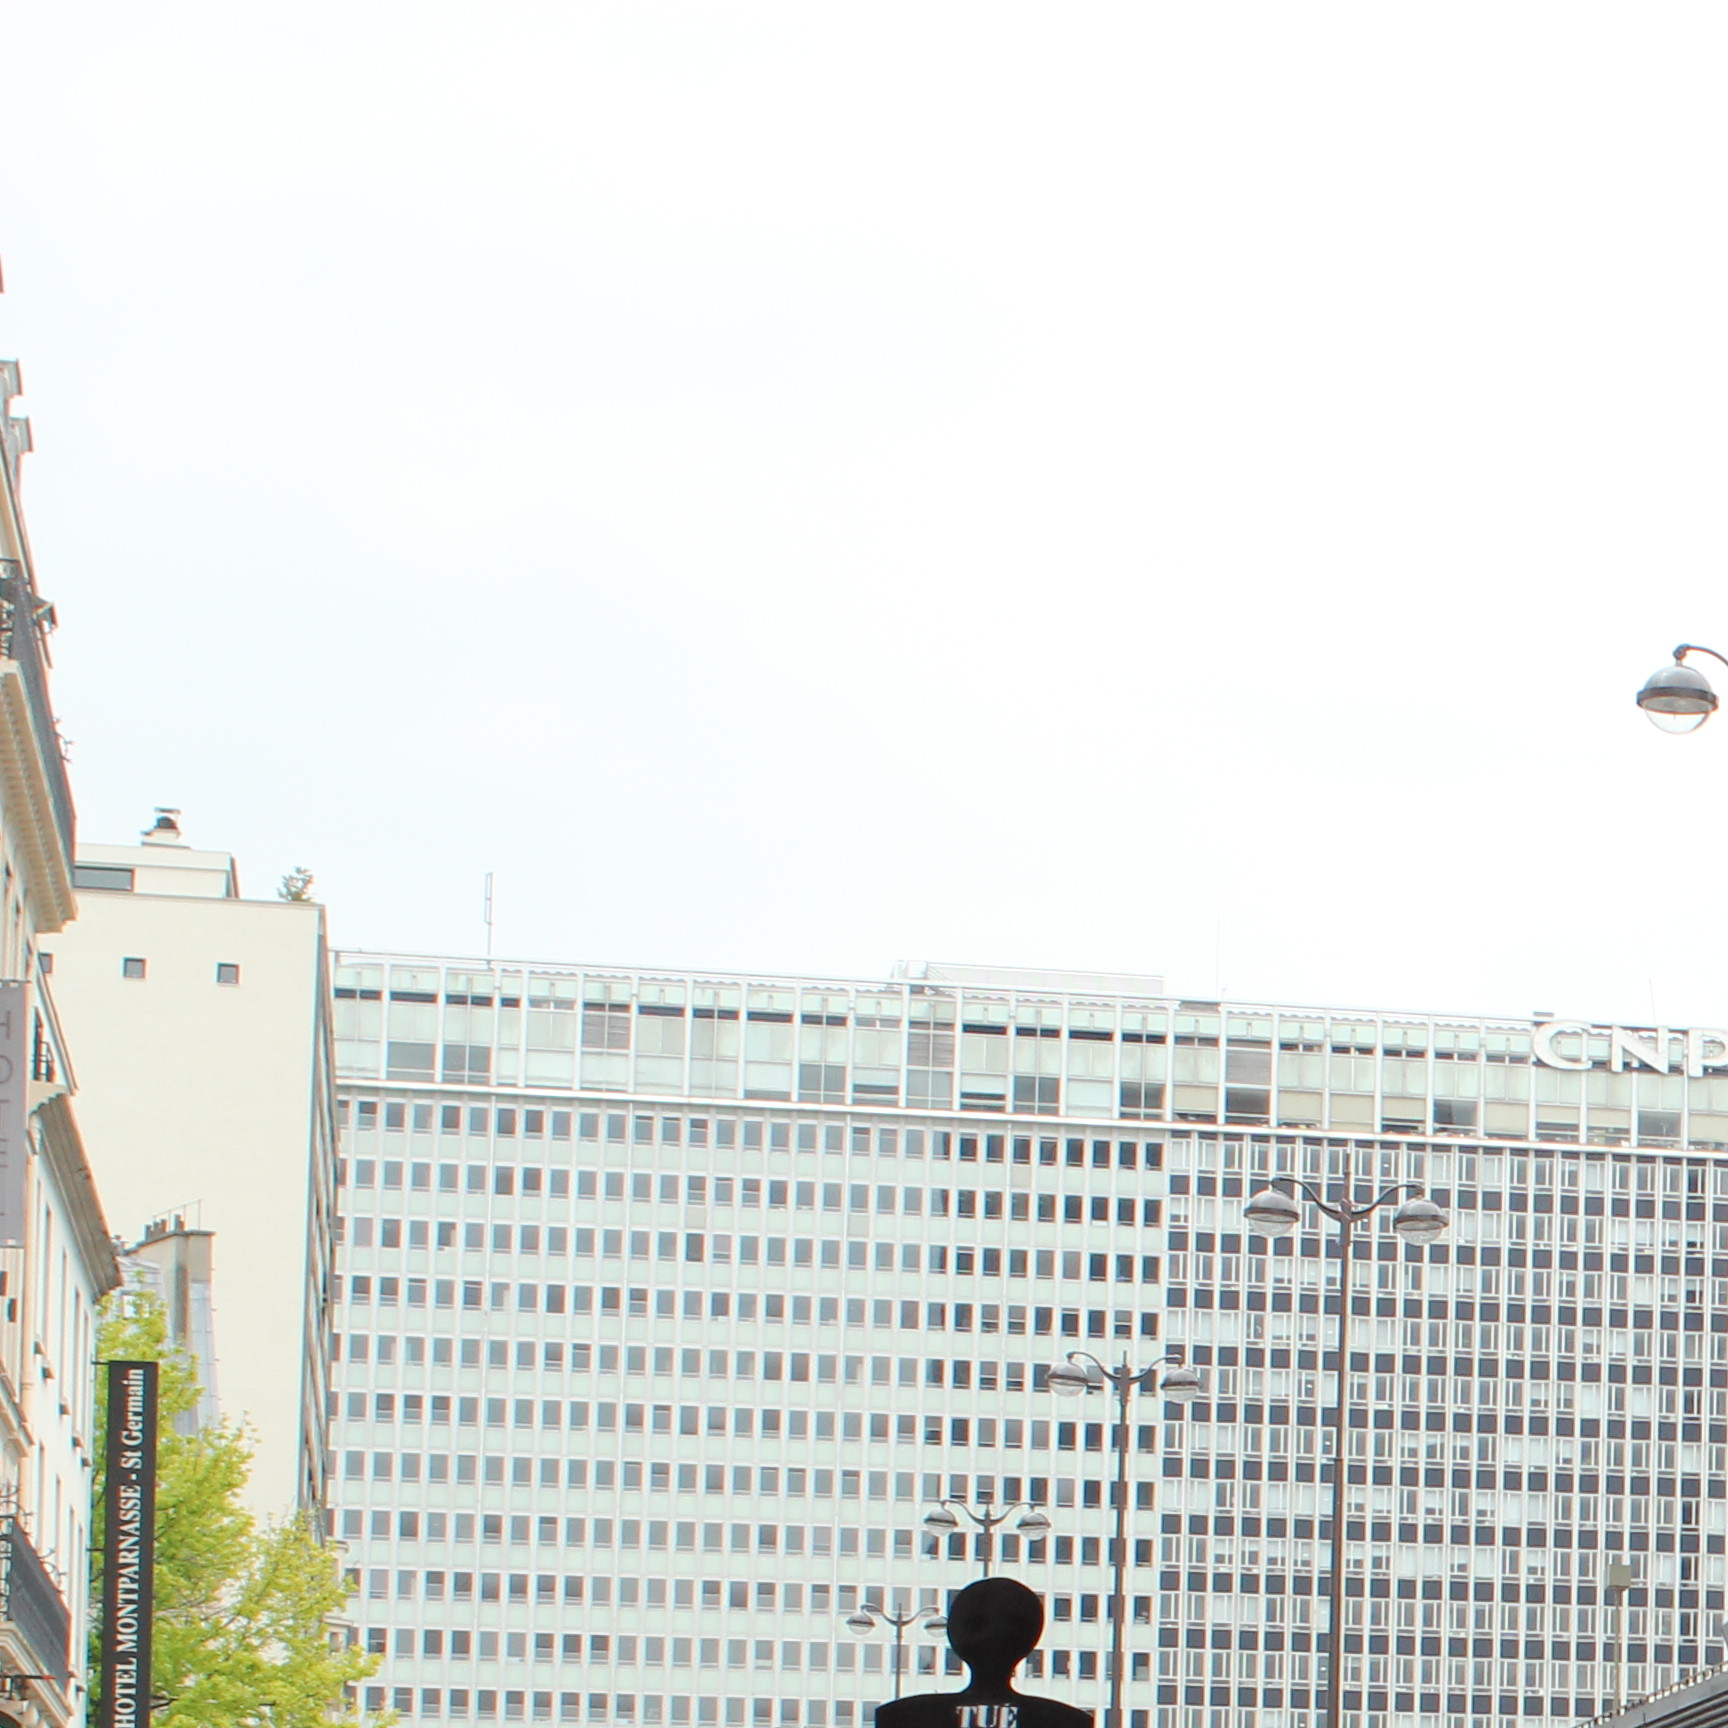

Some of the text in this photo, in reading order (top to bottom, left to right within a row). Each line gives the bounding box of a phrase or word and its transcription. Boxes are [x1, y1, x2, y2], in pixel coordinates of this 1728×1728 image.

[121, 1367, 145, 1447] Germain
[118, 1447, 142, 1470] St
[114, 1485, 142, 1653] MONTPARNASSE
